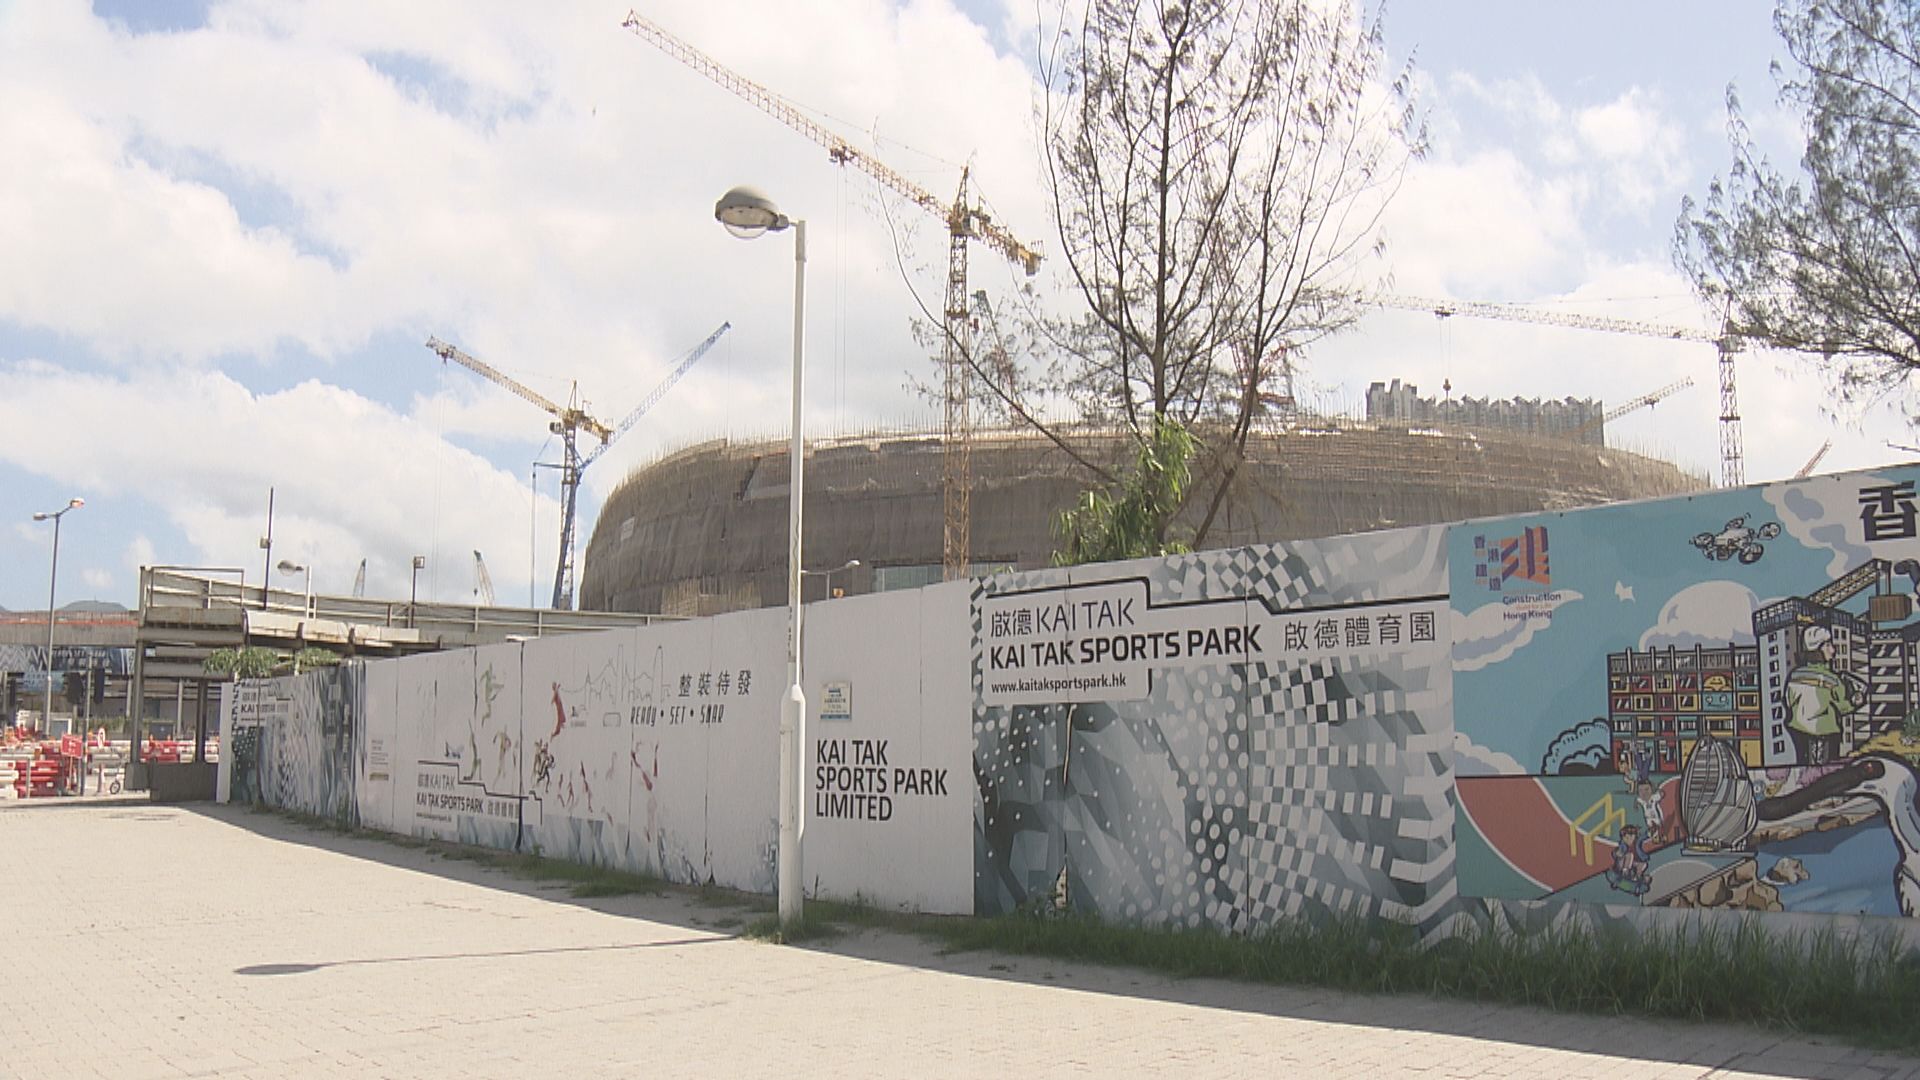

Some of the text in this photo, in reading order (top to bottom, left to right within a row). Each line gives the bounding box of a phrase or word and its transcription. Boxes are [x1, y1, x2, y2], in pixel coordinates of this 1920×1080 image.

[1858, 480, 1919, 542] 香
[1502, 592, 1562, 605] Construction
[1036, 597, 1136, 634] KAI TAK
[1503, 609, 1552, 621] Hong Kong
[990, 623, 1263, 670] KAI TAK SPORTS PARK
[677, 669, 752, 698] 整裝待發
[990, 672, 1127, 694] www.kaitaksportspark.hk
[669, 703, 686, 725] SET
[816, 739, 889, 766] KAI TAK
[430, 774, 441, 789] KAI
[442, 774, 456, 791] TAK
[815, 766, 948, 796] SPORTS PARK
[416, 792, 427, 805] KAI
[428, 793, 439, 808] TAK
[440, 794, 466, 811] SPORTS
[466, 797, 484, 813] PARK
[815, 792, 893, 822] LIMITED
